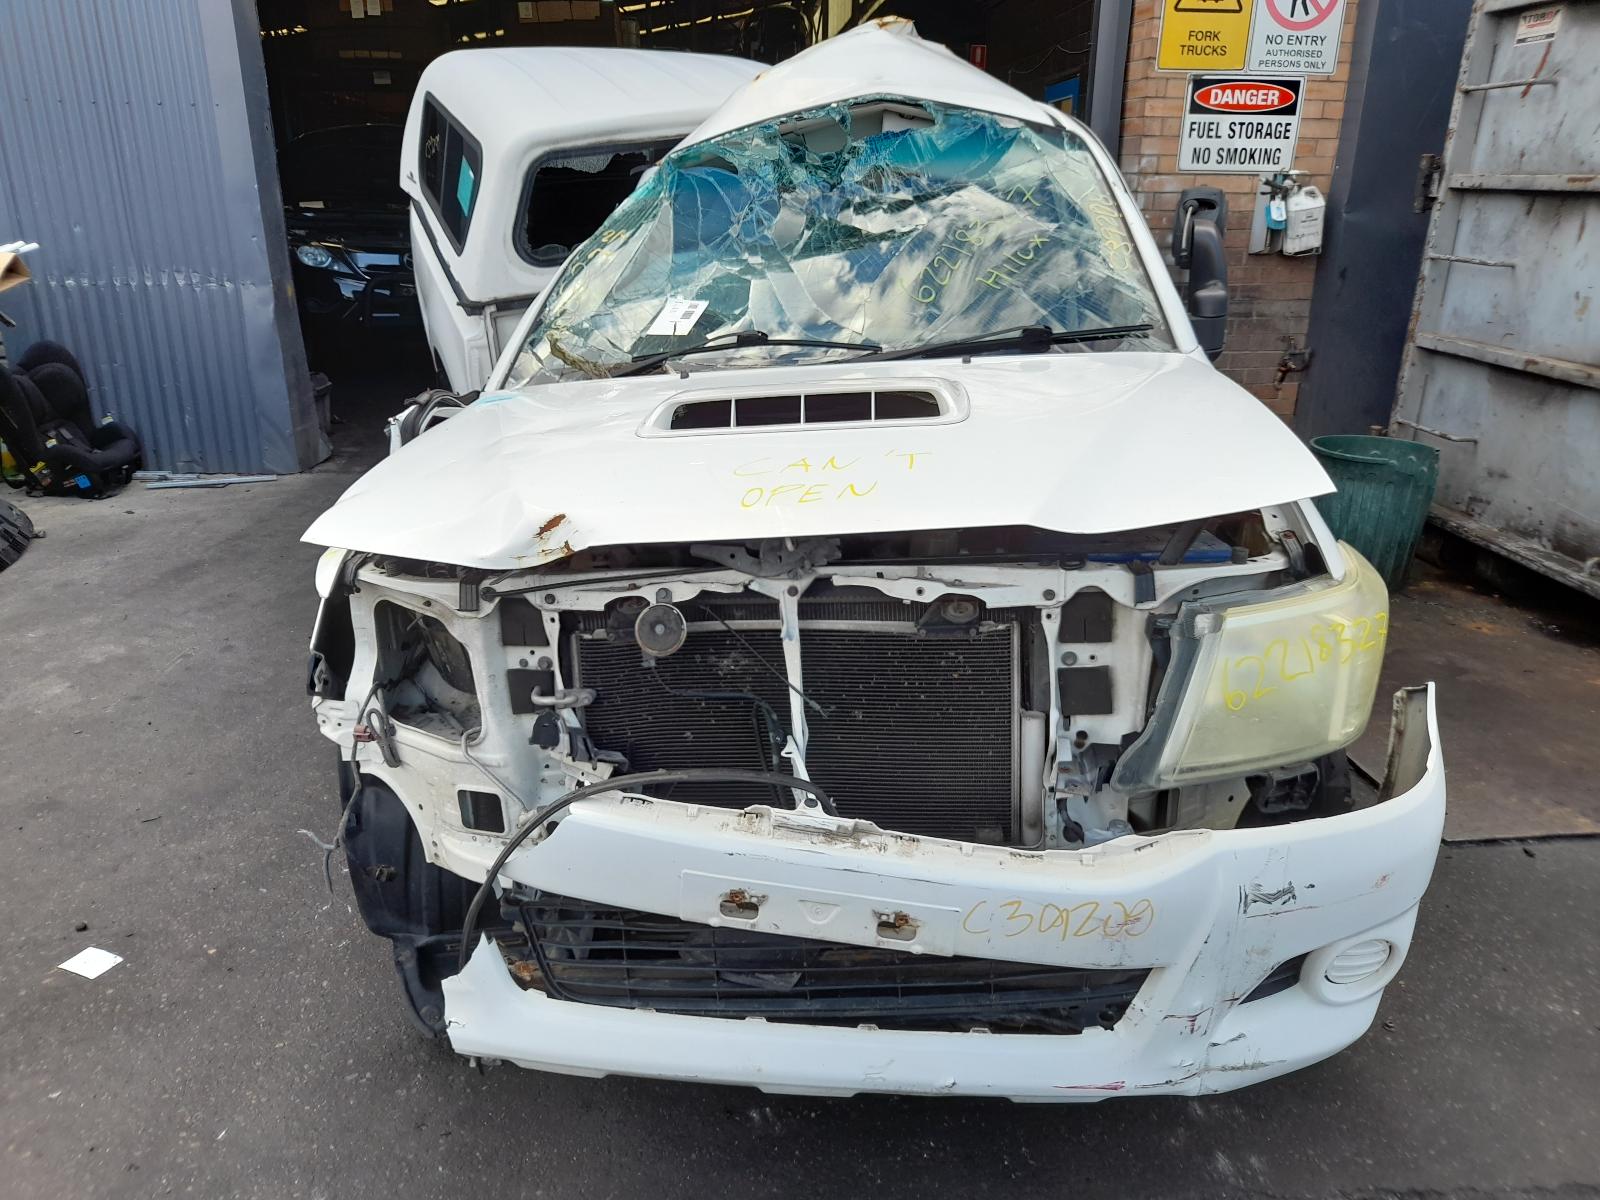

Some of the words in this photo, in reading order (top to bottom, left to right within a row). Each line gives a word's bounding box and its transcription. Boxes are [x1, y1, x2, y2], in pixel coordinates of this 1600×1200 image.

[1188, 30, 1221, 42] FORK
[1265, 34, 1284, 45] NO
[1287, 34, 1327, 46] ENTRY
[1180, 45, 1227, 56] TRUCKS
[1265, 49, 1323, 58] AUTHORISED
[1258, 60, 1301, 68] PERSONS
[1304, 61, 1327, 69] ONLY
[1209, 89, 1280, 106] DANGER
[1188, 121, 1222, 139] FUEL
[1228, 122, 1292, 140] STORAGE
[1191, 147, 1211, 165] NO
[1215, 147, 1281, 165] SMOKING
[740, 481, 878, 508] OPEN
